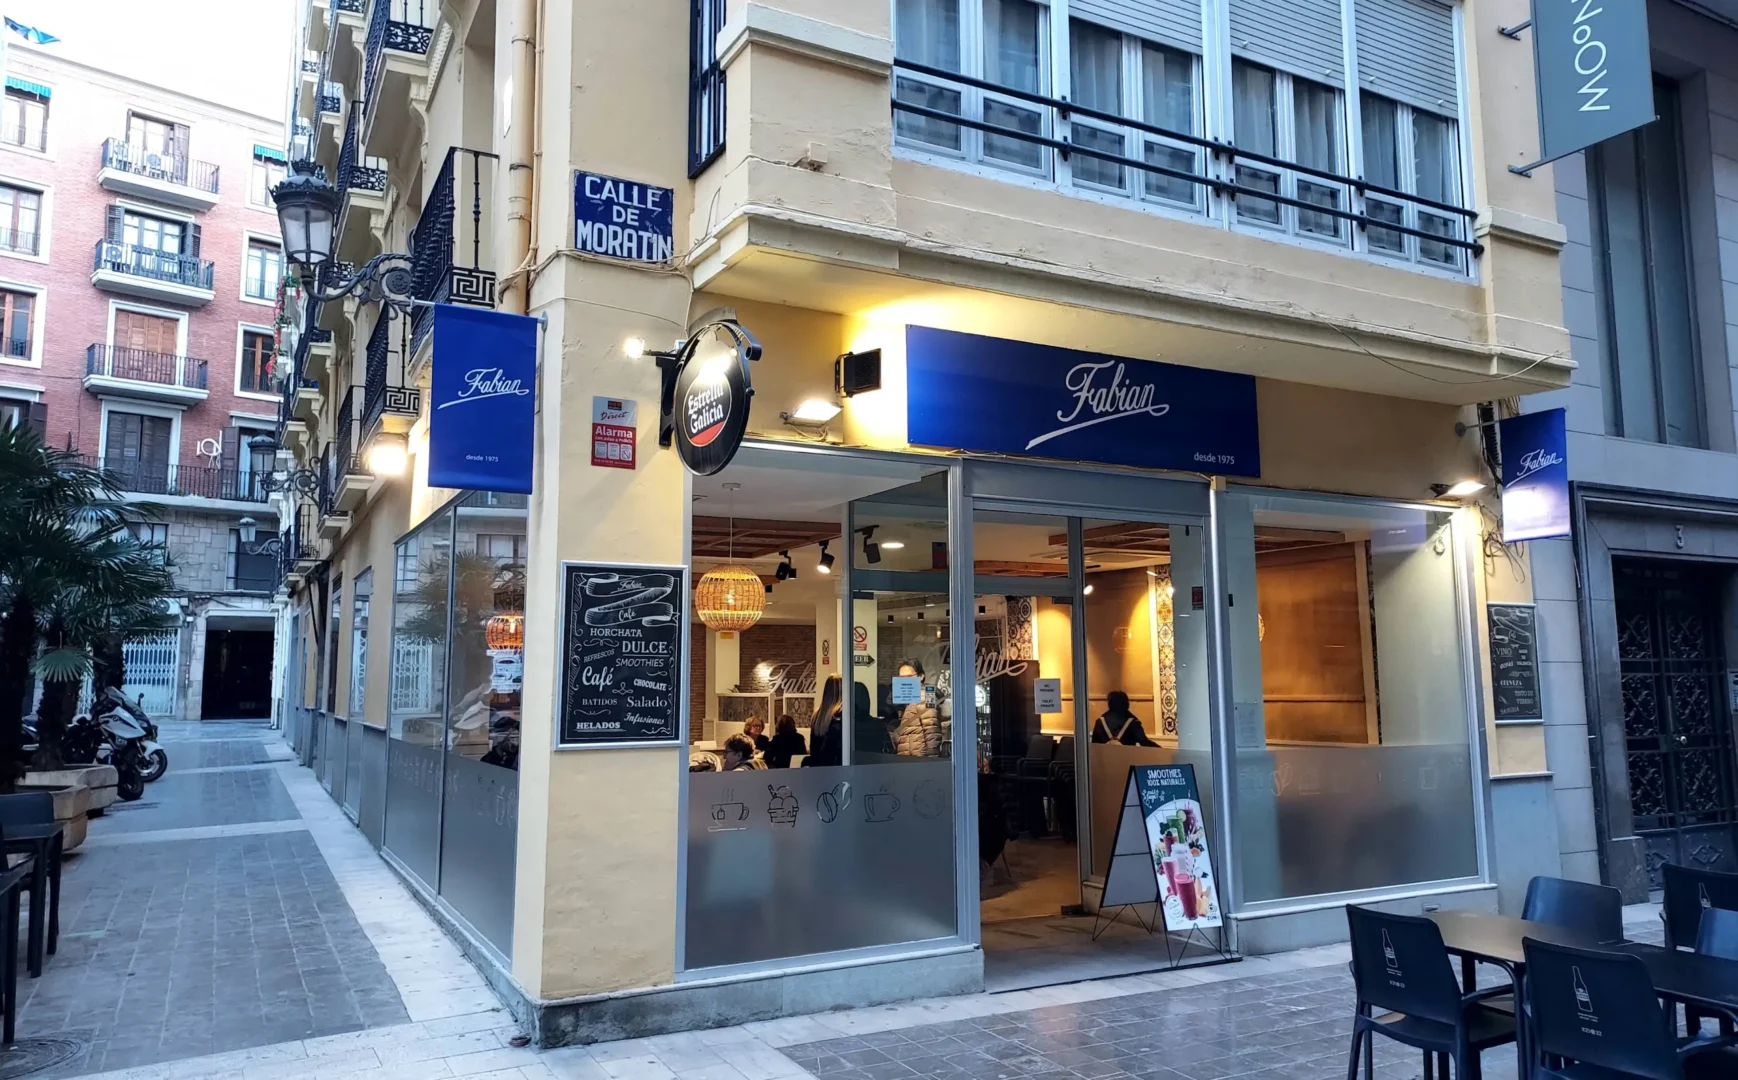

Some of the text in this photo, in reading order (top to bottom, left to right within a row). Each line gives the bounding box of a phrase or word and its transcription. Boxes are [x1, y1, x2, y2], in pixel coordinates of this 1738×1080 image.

[585, 176, 662, 211] CALLE
[612, 205, 639, 226] DE
[450, 367, 529, 402] Fabian
[688, 383, 724, 415] Estrella
[1042, 360, 1170, 434] Fabian
[690, 404, 724, 434] Galicia
[595, 425, 633, 438] Alarma
[466, 453, 499, 463] desde 1975
[1194, 452, 1235, 465] desde 1975
[1511, 449, 1563, 482] Fabian
[1675, 525, 1684, 549] 3
[618, 608, 636, 622] Café
[590, 628, 643, 638] HORCHATA
[622, 641, 668, 654] DULCE
[1496, 647, 1512, 656] VINO
[583, 649, 615, 663] REFRESCOS
[615, 658, 664, 667] SMOOTHIES
[582, 665, 614, 692] Café
[633, 678, 667, 691] CHOCOLATE
[582, 698, 618, 706] BATIDOS
[626, 695, 668, 708] Salado
[624, 712, 665, 725] Infusiones
[576, 722, 621, 730] HELADOS
[1147, 769, 1182, 779] SMOOTHIES
[1147, 778, 1187, 788] 100% NATURALES
